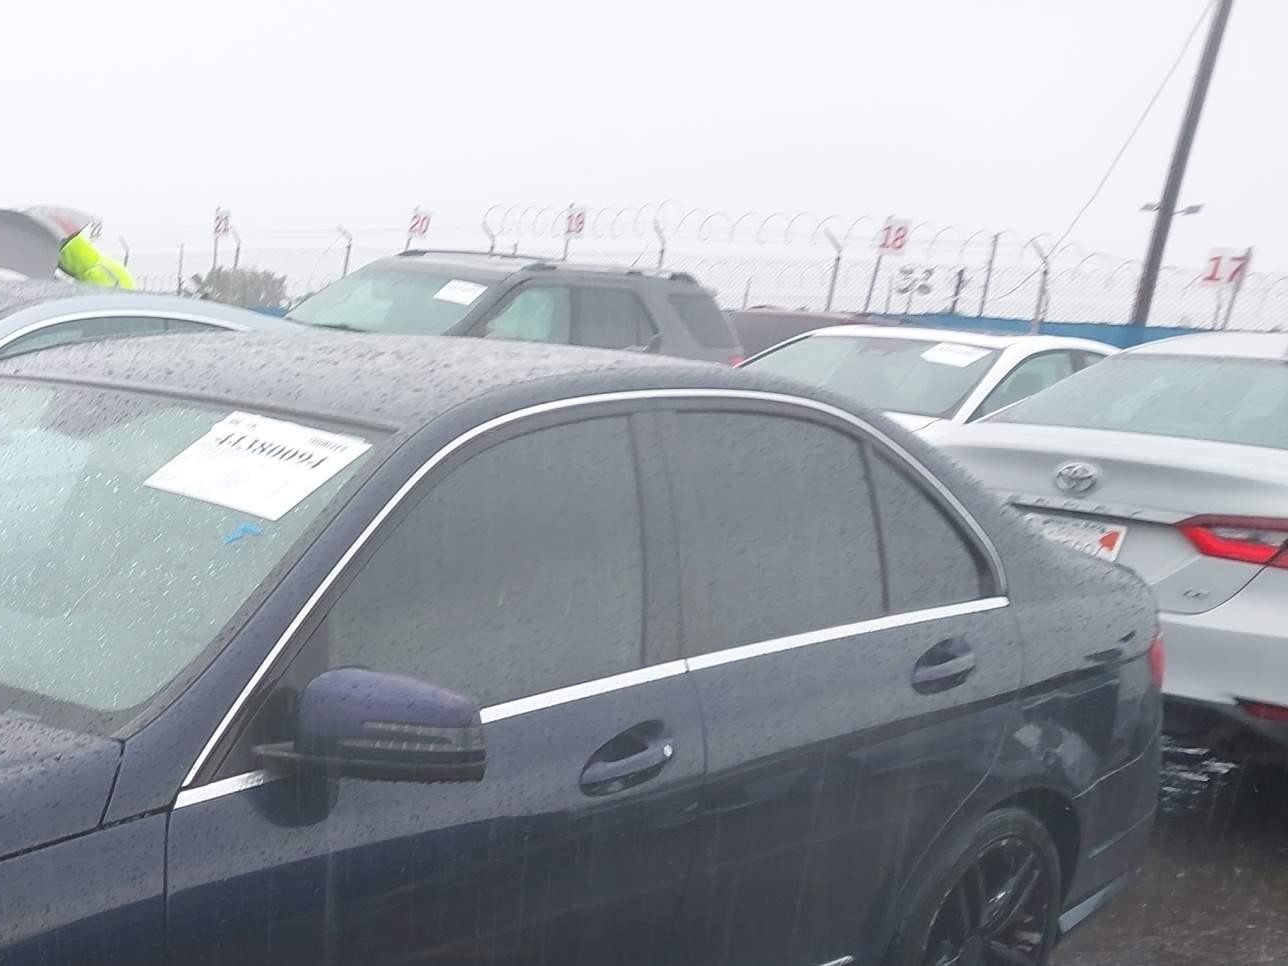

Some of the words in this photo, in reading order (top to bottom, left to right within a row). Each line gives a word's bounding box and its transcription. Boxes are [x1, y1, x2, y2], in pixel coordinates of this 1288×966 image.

[409, 214, 432, 234] 20
[879, 223, 908, 251] 18
[1202, 255, 1248, 283] 17
[215, 432, 329, 470] 44380094
